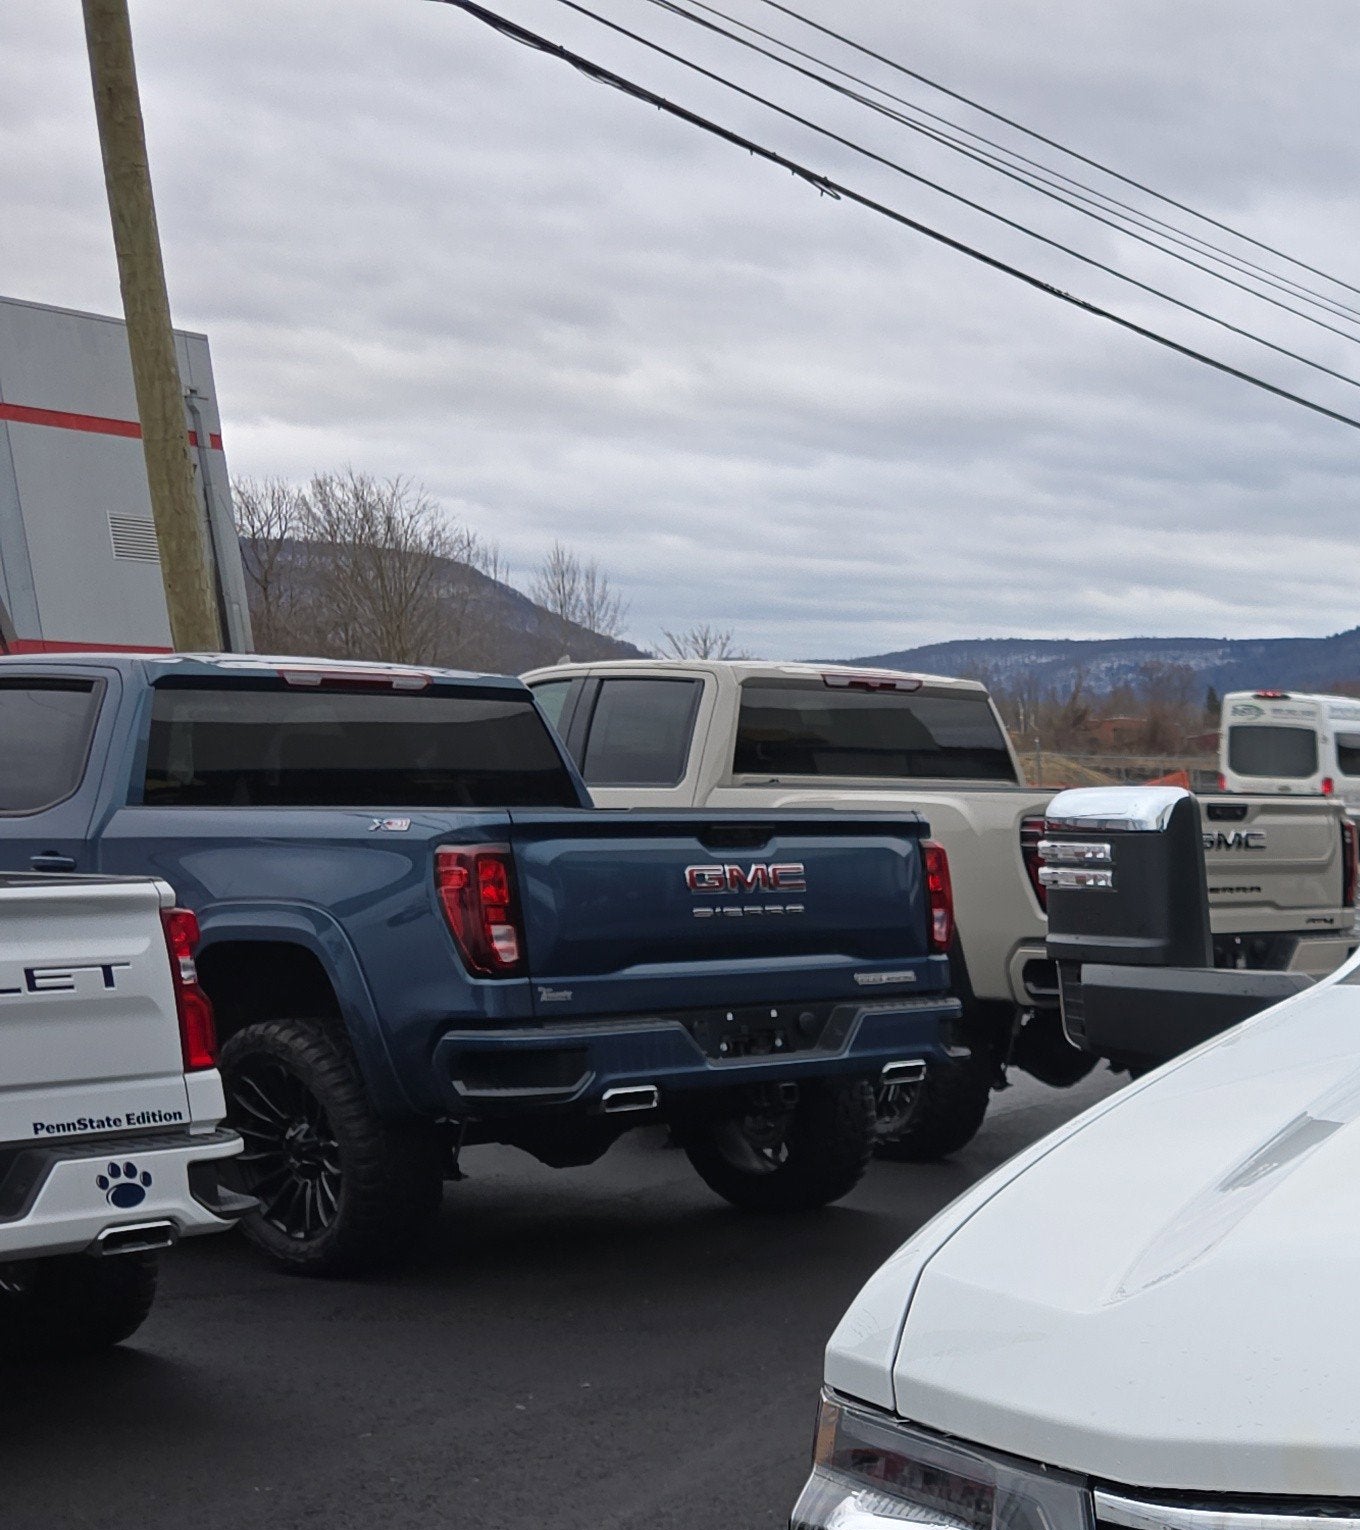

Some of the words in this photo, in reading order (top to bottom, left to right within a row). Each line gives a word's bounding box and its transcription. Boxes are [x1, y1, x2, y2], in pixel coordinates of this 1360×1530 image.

[685, 863, 806, 894] GMC
[32, 1117, 122, 1135] PennState
[125, 1110, 183, 1126] Edition
